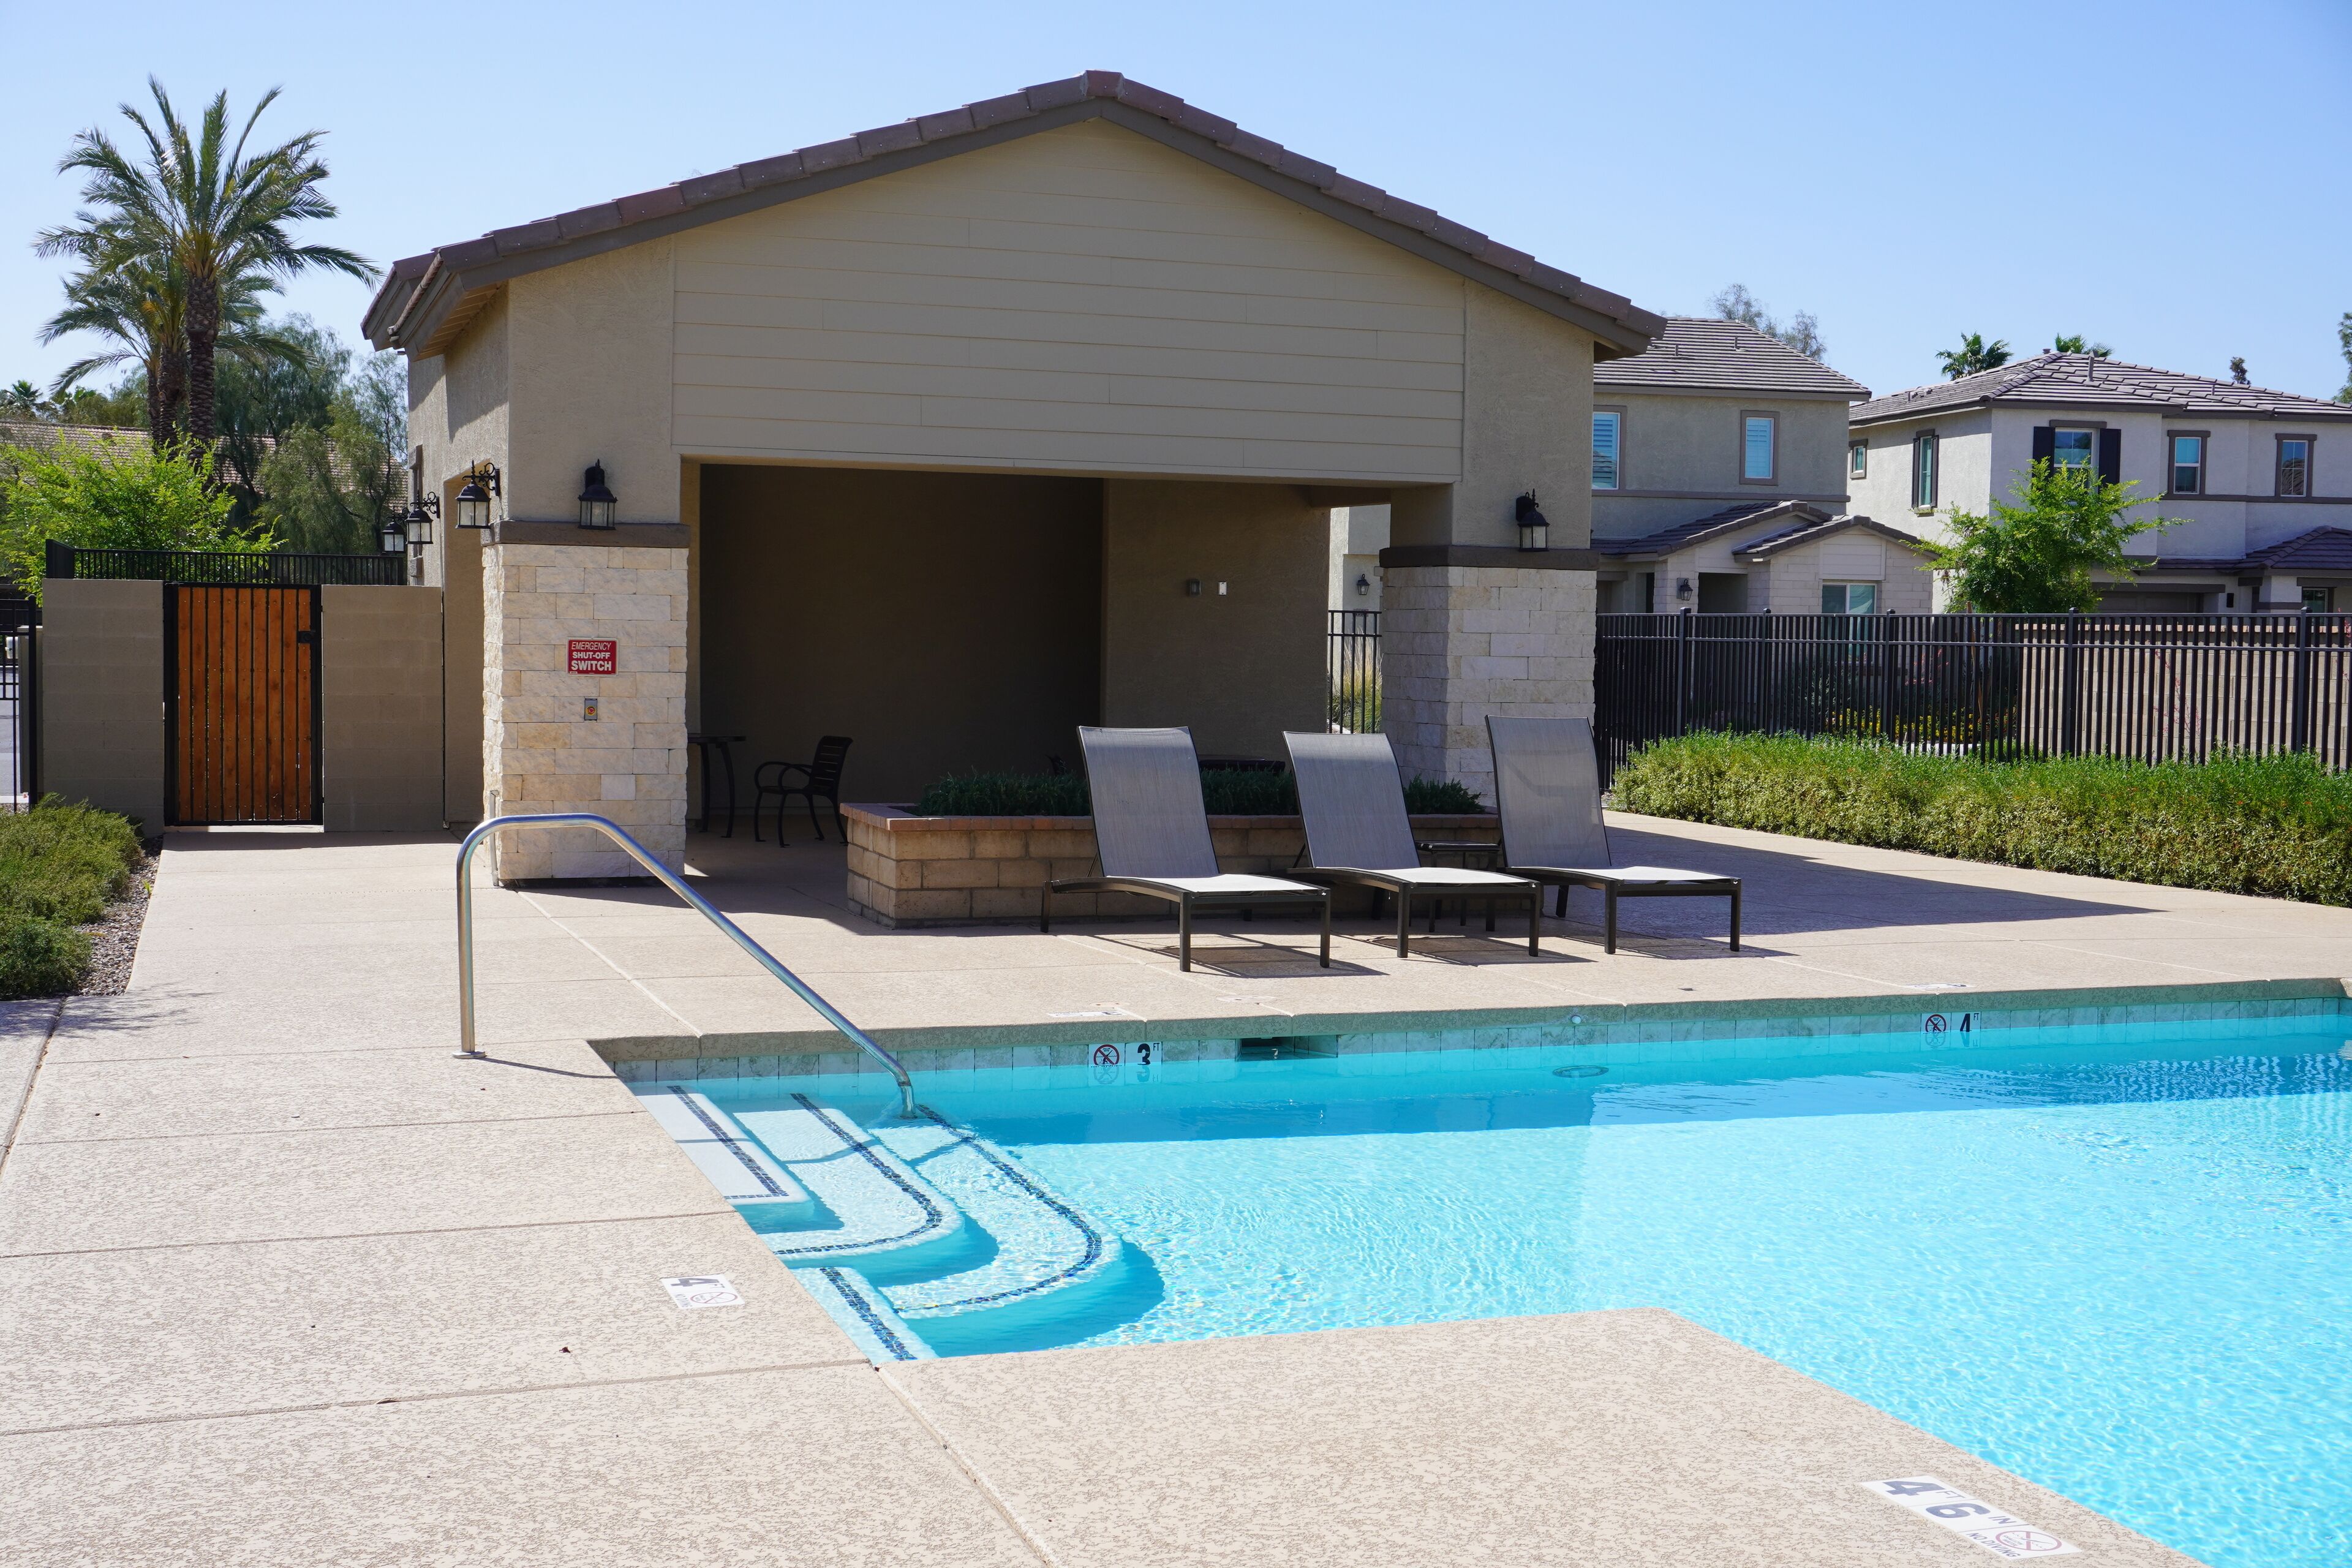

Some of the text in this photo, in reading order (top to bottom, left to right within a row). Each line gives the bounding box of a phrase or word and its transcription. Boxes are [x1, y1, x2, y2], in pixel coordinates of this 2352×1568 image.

[571, 660, 612, 671] SWITCH
[1973, 1012, 1980, 1021] FT
[1137, 1042, 1160, 1066] 3 FT
[670, 1277, 720, 1287] 4
[1882, 1480, 2017, 1525] 4 FT 6 IN
[1981, 1540, 2021, 1558] DIVING
